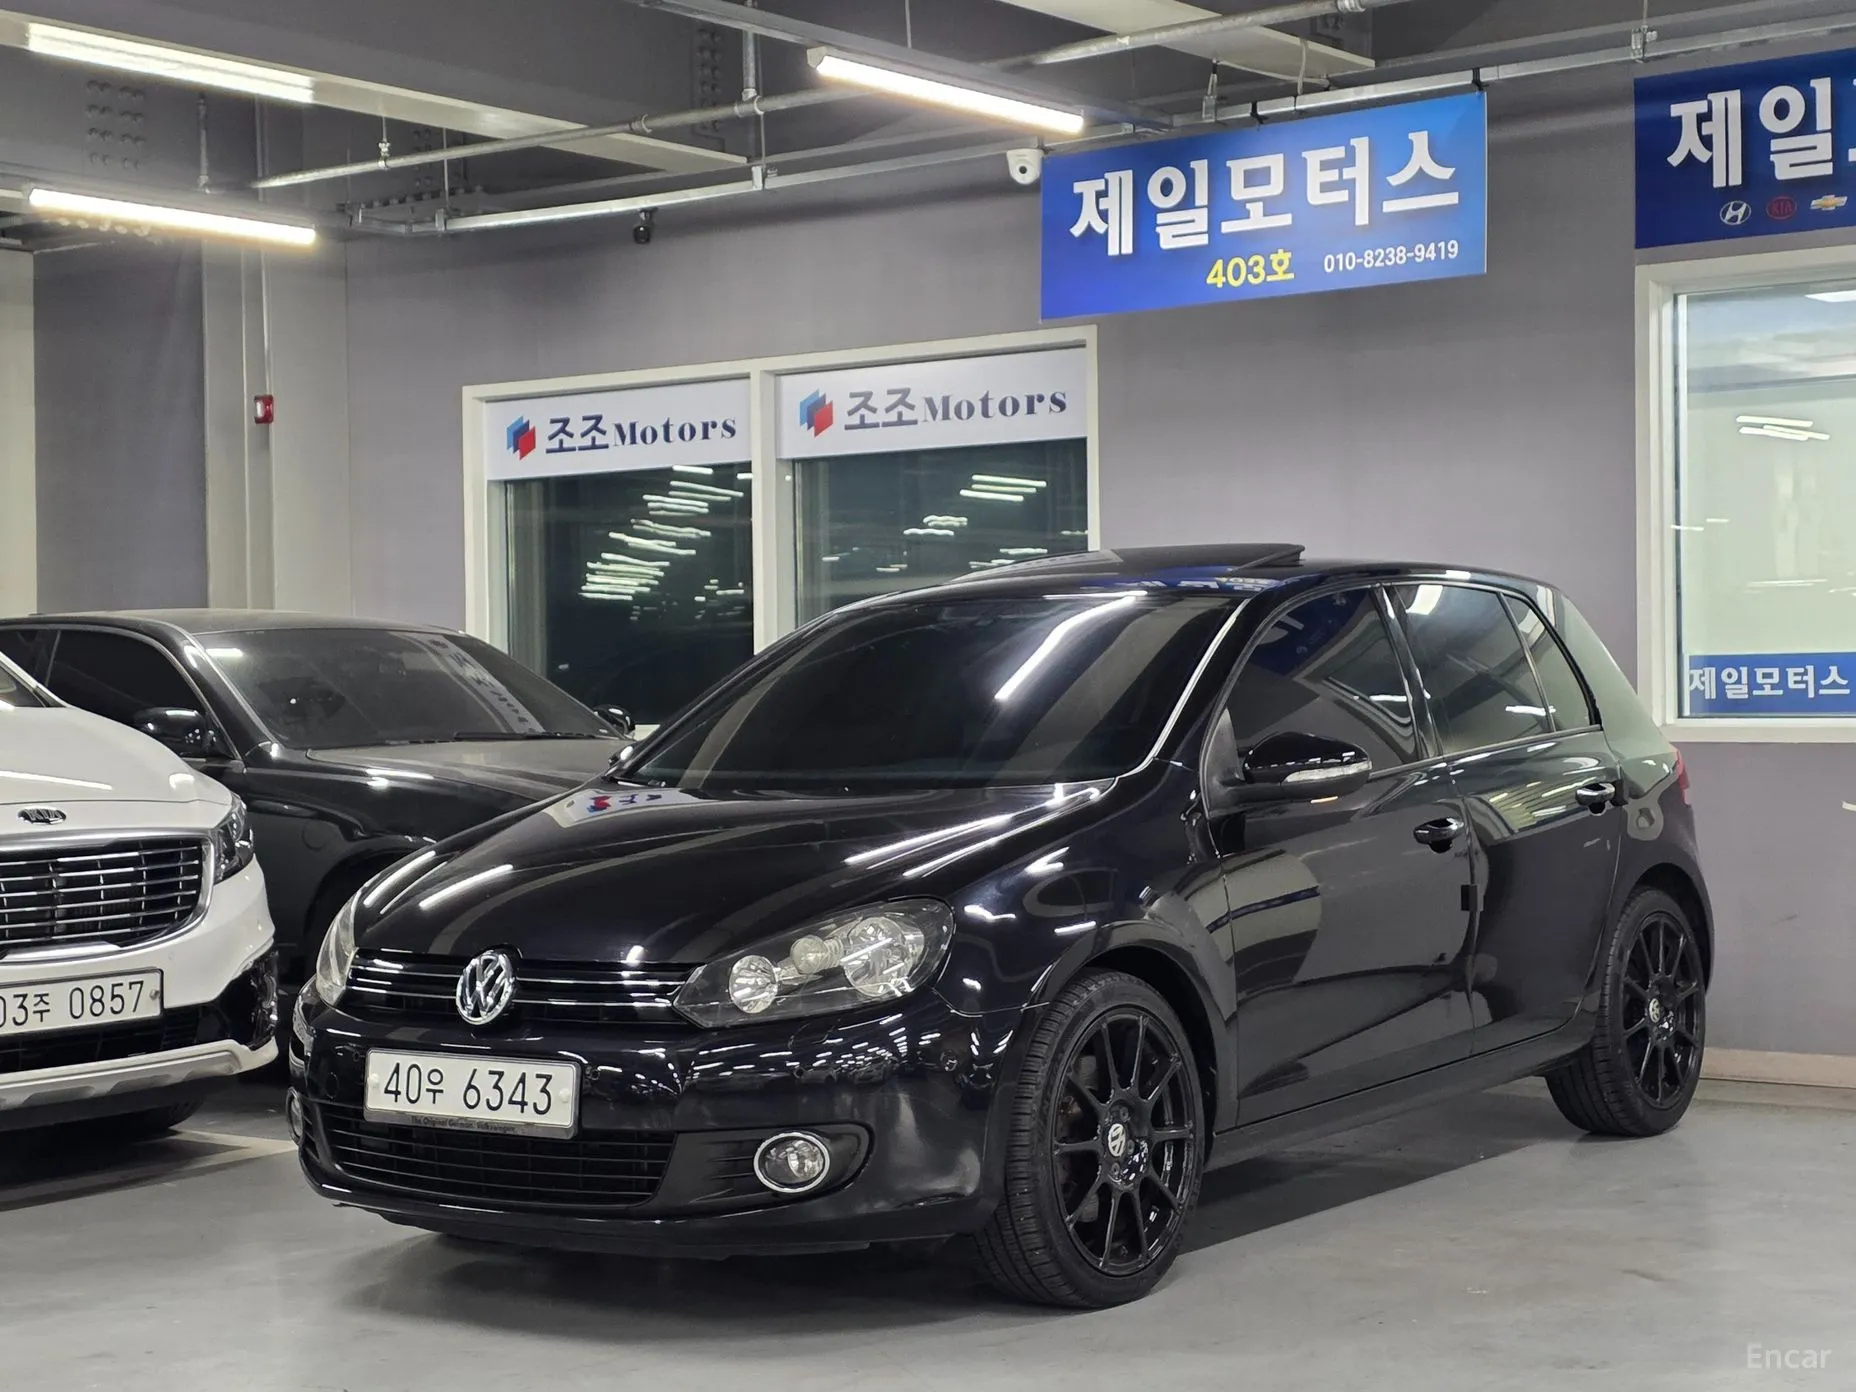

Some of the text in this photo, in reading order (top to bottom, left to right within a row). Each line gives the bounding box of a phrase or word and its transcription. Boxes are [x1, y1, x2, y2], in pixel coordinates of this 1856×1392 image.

[1667, 77, 1856, 188] 제일
[1070, 130, 1459, 256] 제일모터스
[1206, 239, 1459, 288] 403호 010-8238-9419
[1689, 665, 1850, 699] 제일모터스
[69, 980, 144, 1019] 0857
[384, 1062, 553, 1115] 40우 6343
